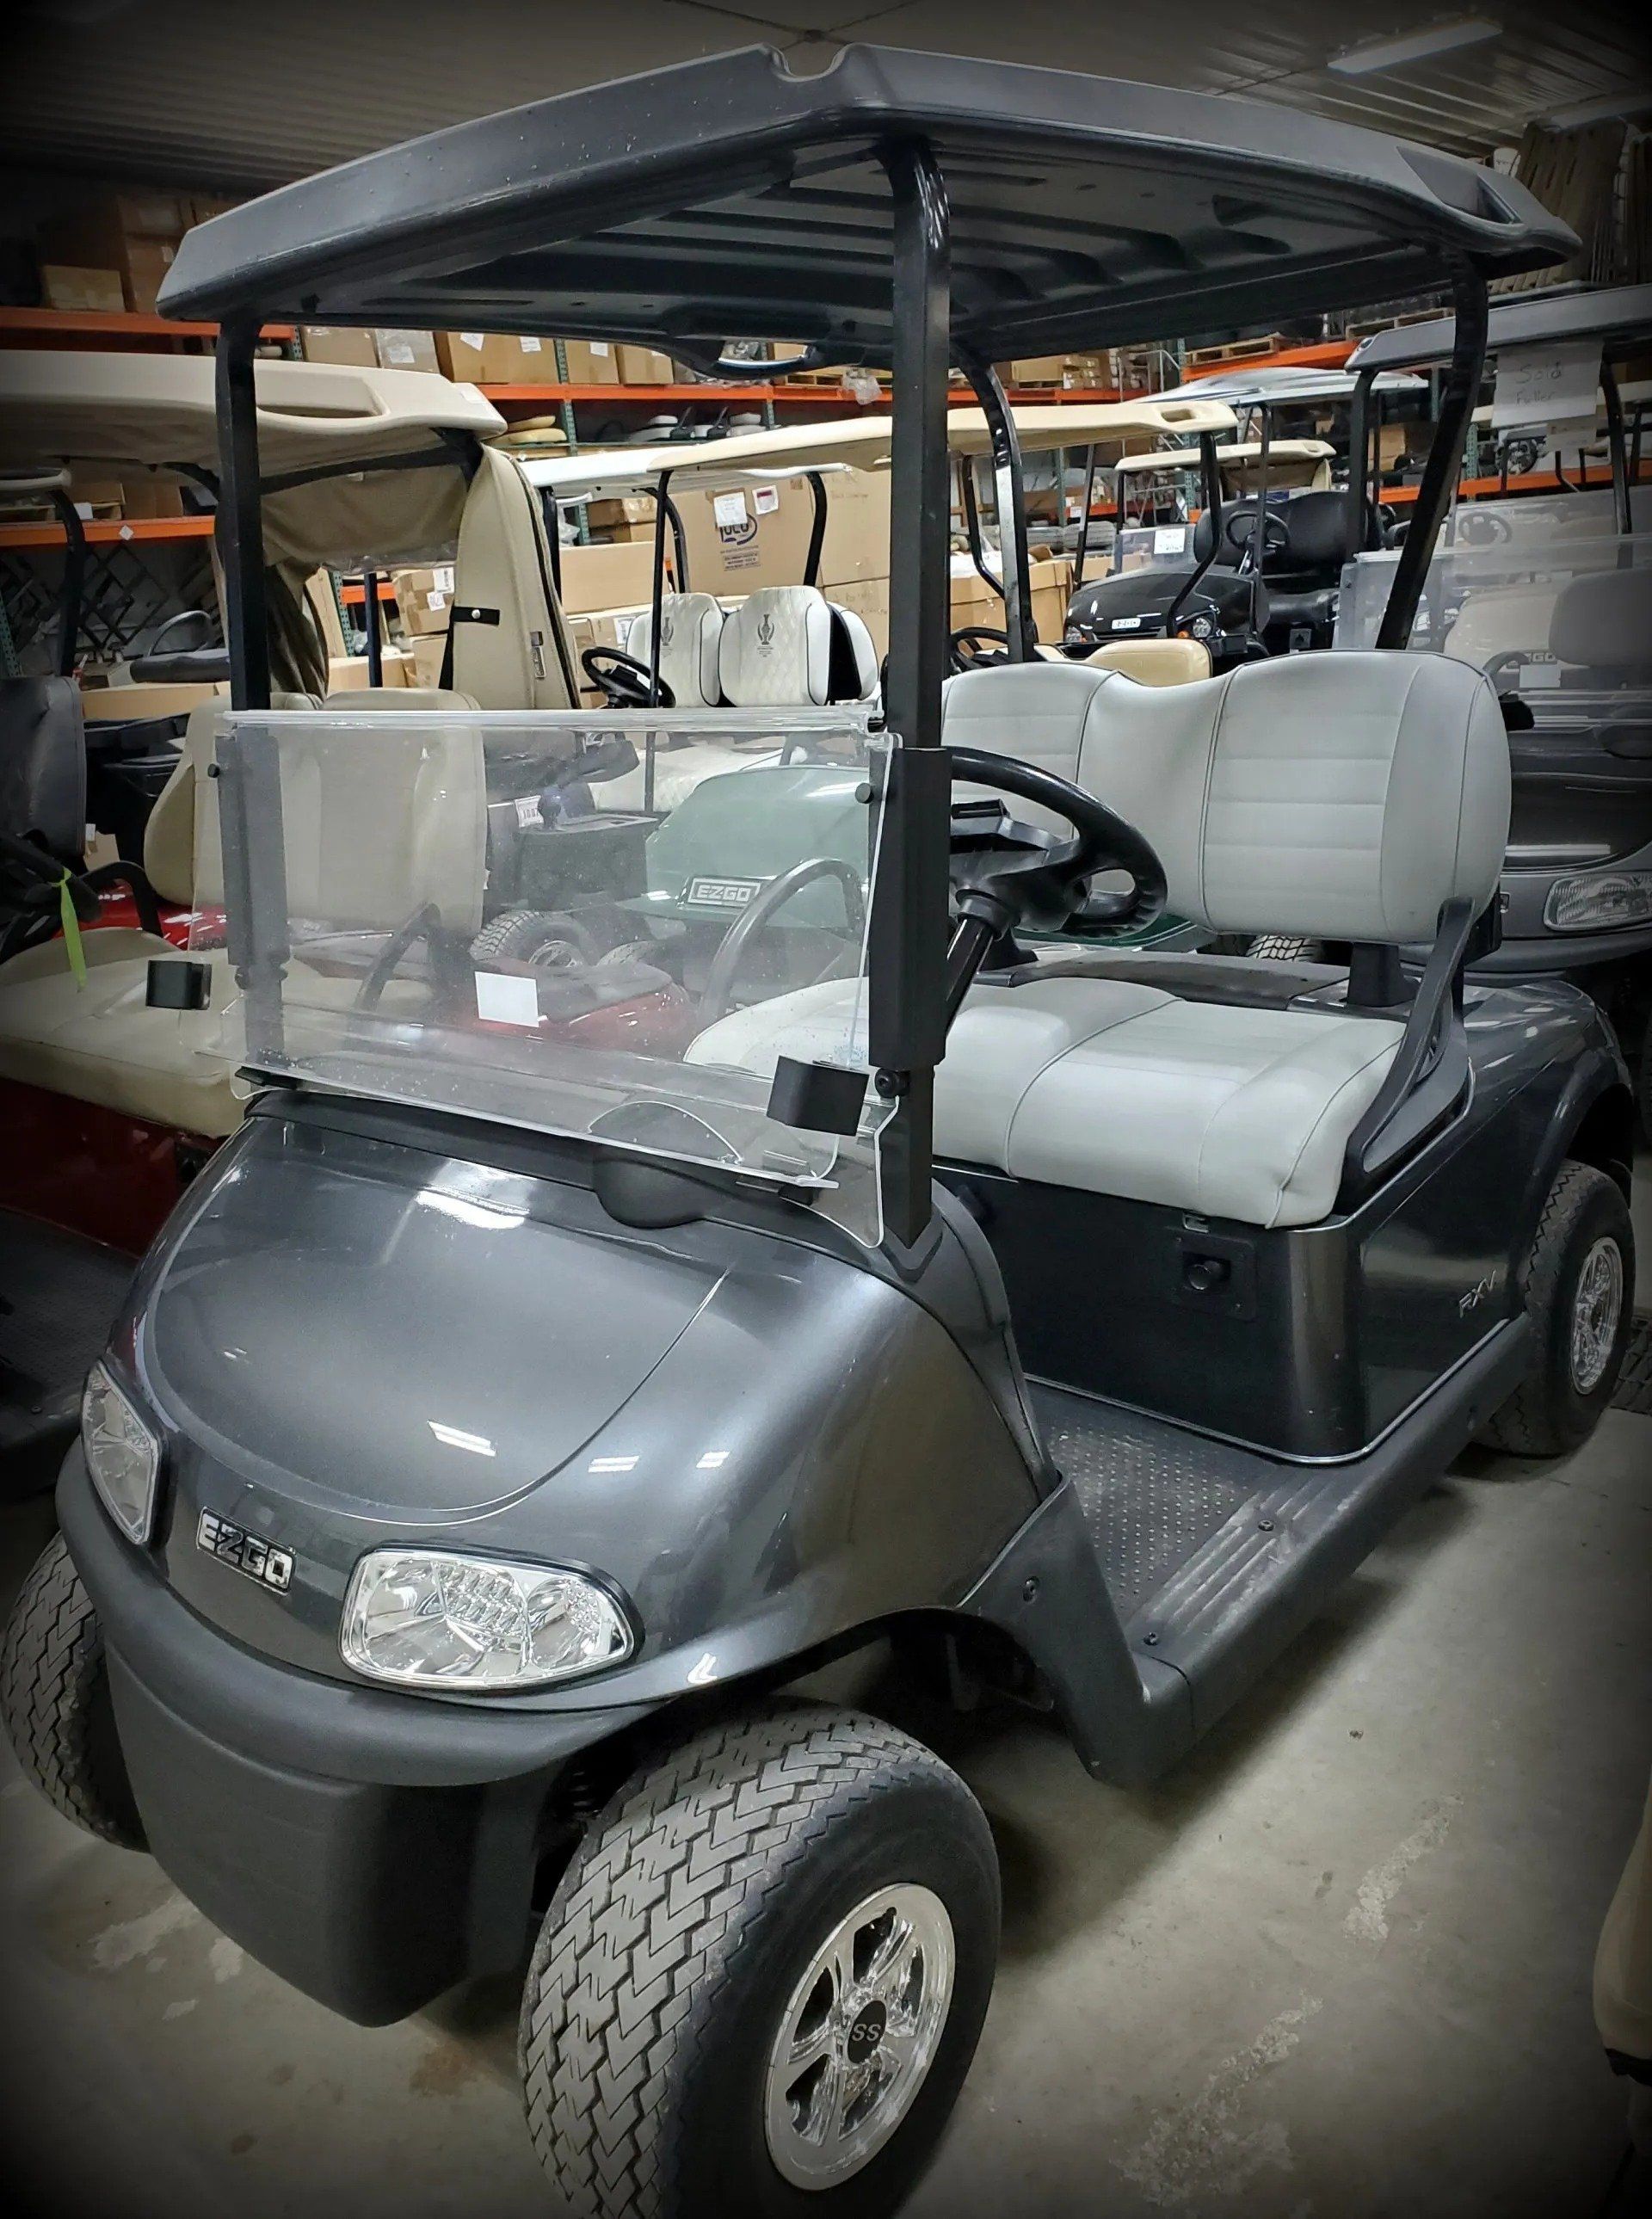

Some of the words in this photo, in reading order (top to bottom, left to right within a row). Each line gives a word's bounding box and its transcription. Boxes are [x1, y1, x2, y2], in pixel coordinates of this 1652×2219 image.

[1515, 360, 1563, 384] Sold
[697, 885, 751, 902] EZGO
[1459, 1269, 1497, 1318] RXV
[199, 1513, 293, 1589] EZGO
[852, 2024, 881, 2041] SS
